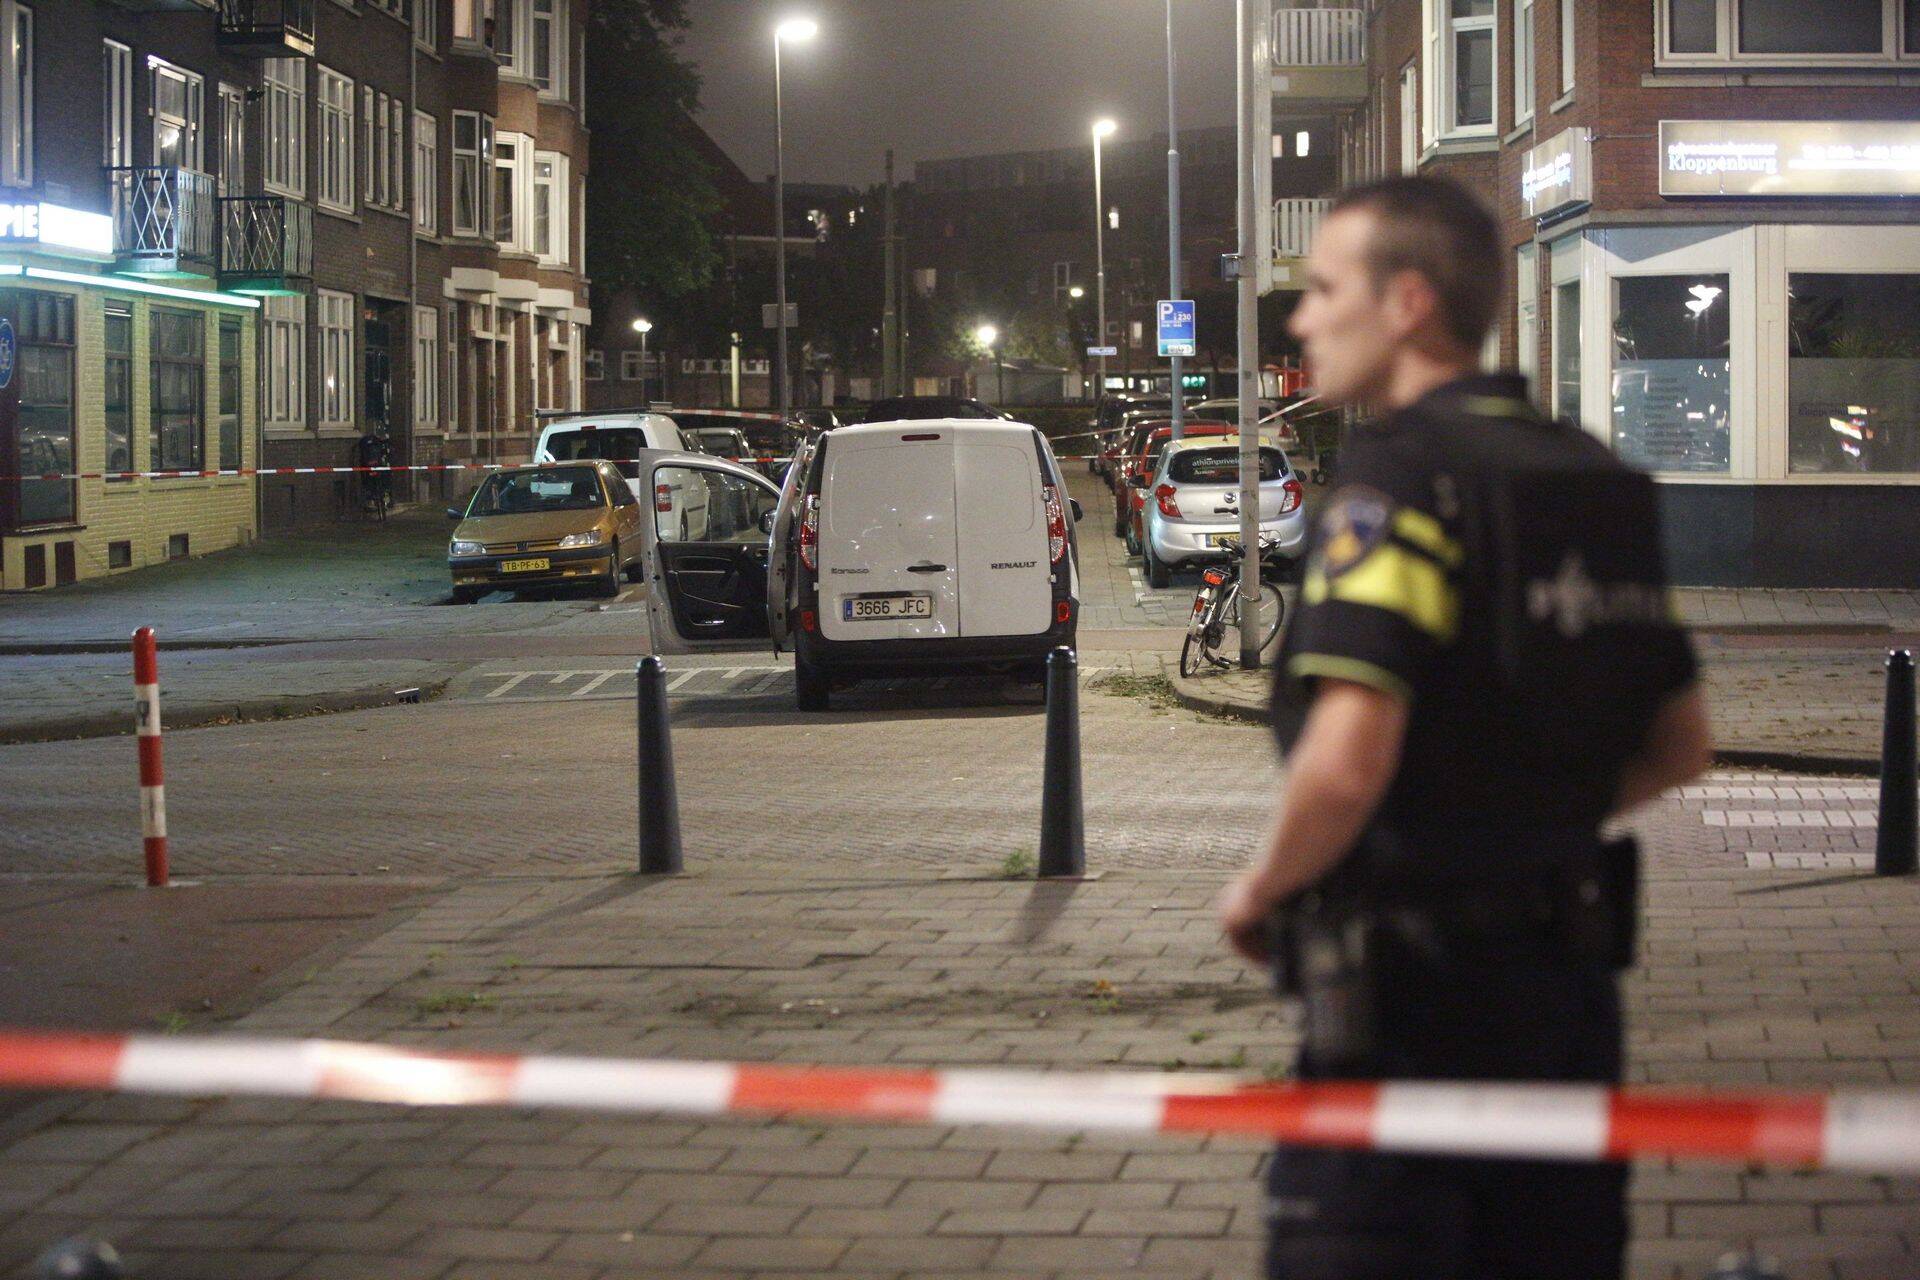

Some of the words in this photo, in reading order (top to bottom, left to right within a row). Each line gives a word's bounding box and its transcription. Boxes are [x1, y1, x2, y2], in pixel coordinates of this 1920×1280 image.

[1668, 155, 1777, 174] Kloppenburg
[991, 561, 1038, 570] RENAULT
[856, 601, 890, 616] 3666
[898, 599, 925, 614] JFC
